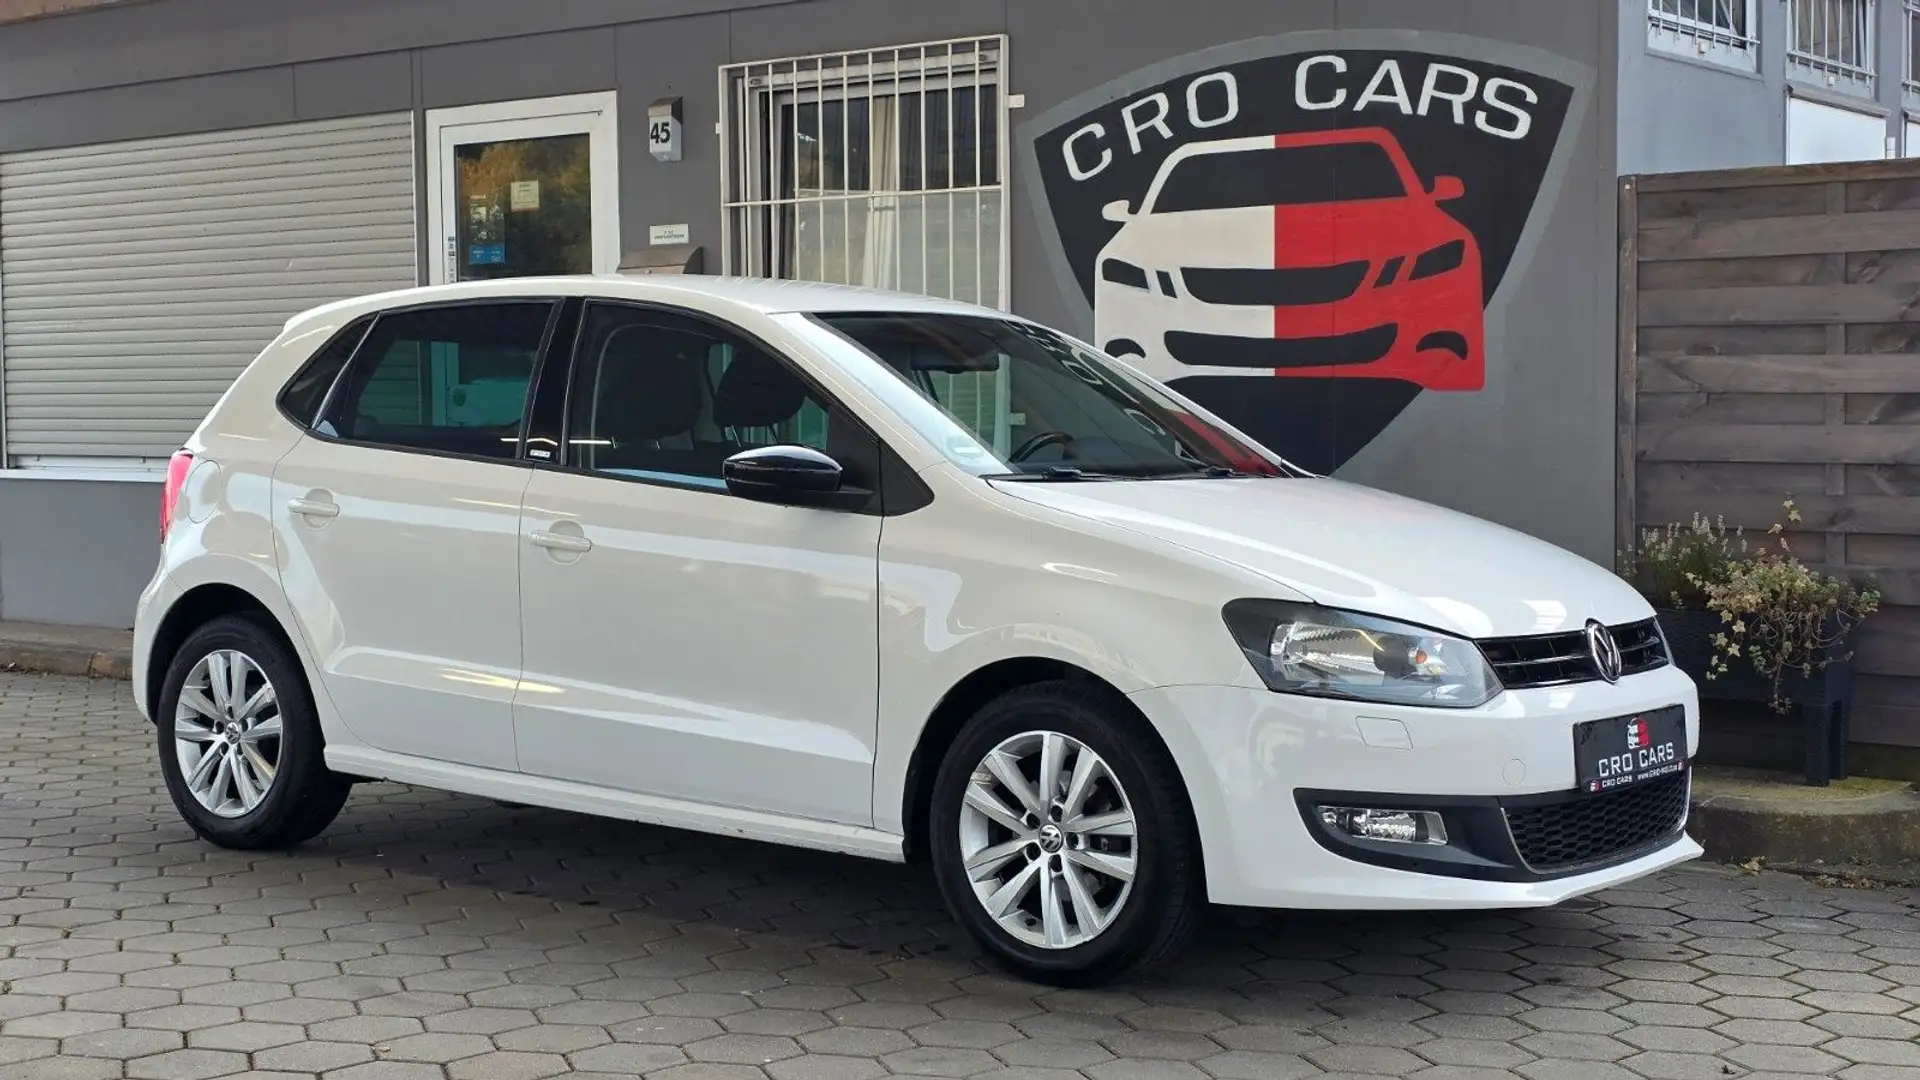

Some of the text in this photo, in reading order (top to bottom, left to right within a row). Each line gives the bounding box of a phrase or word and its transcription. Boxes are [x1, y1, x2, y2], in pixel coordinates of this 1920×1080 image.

[649, 121, 671, 144] 45
[1062, 54, 1538, 182] CRO CARS
[1599, 742, 1674, 777] CRO CARS
[1601, 778, 1616, 789] CRO
[1616, 775, 1632, 785] CARS
